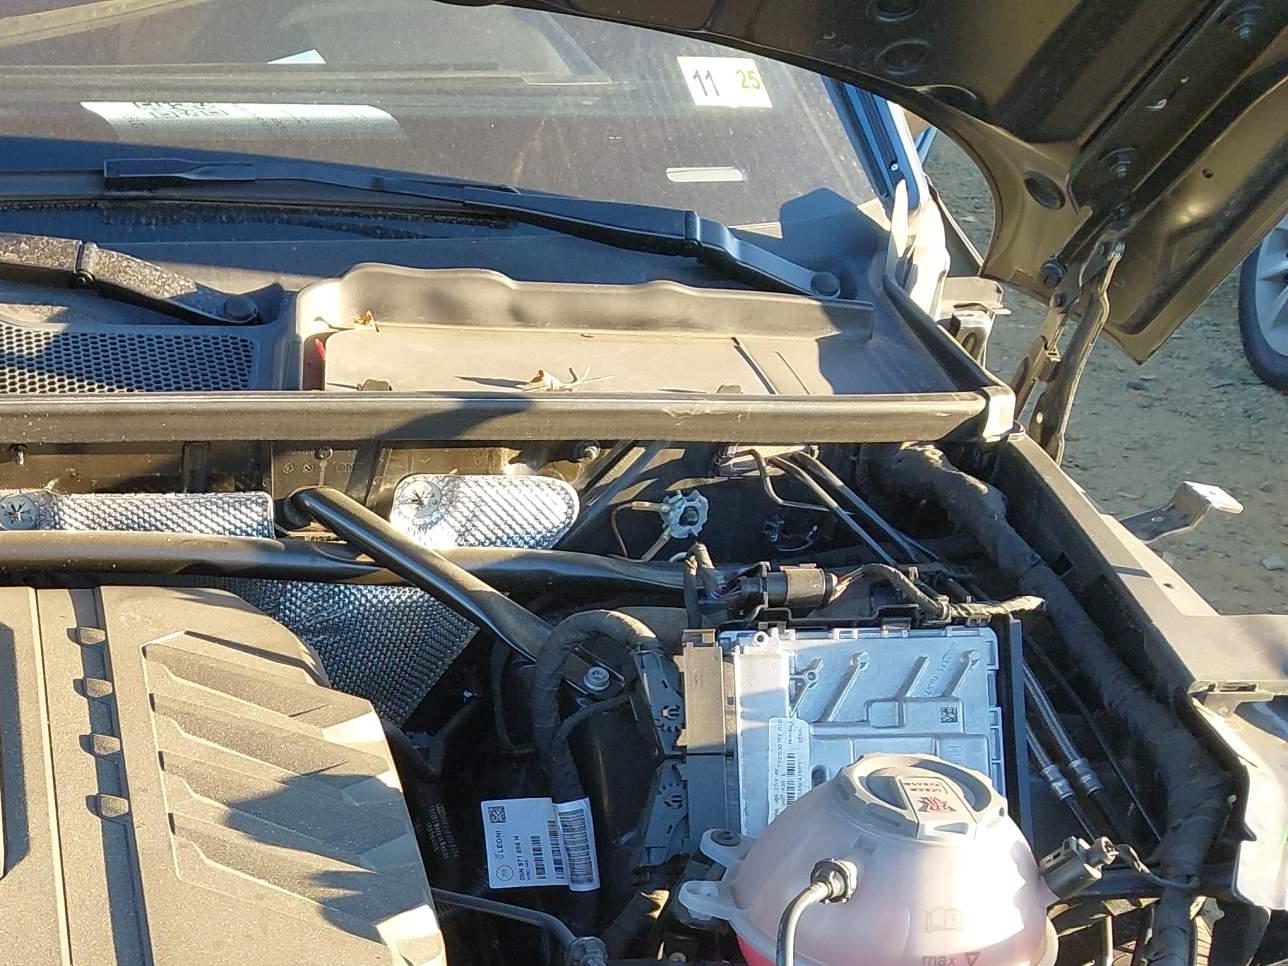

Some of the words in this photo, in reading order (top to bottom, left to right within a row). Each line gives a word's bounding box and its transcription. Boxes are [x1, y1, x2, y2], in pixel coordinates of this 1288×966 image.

[693, 69, 720, 97] 11
[736, 70, 761, 90] 25
[495, 830, 504, 853] LEONI
[922, 955, 957, 966] max
